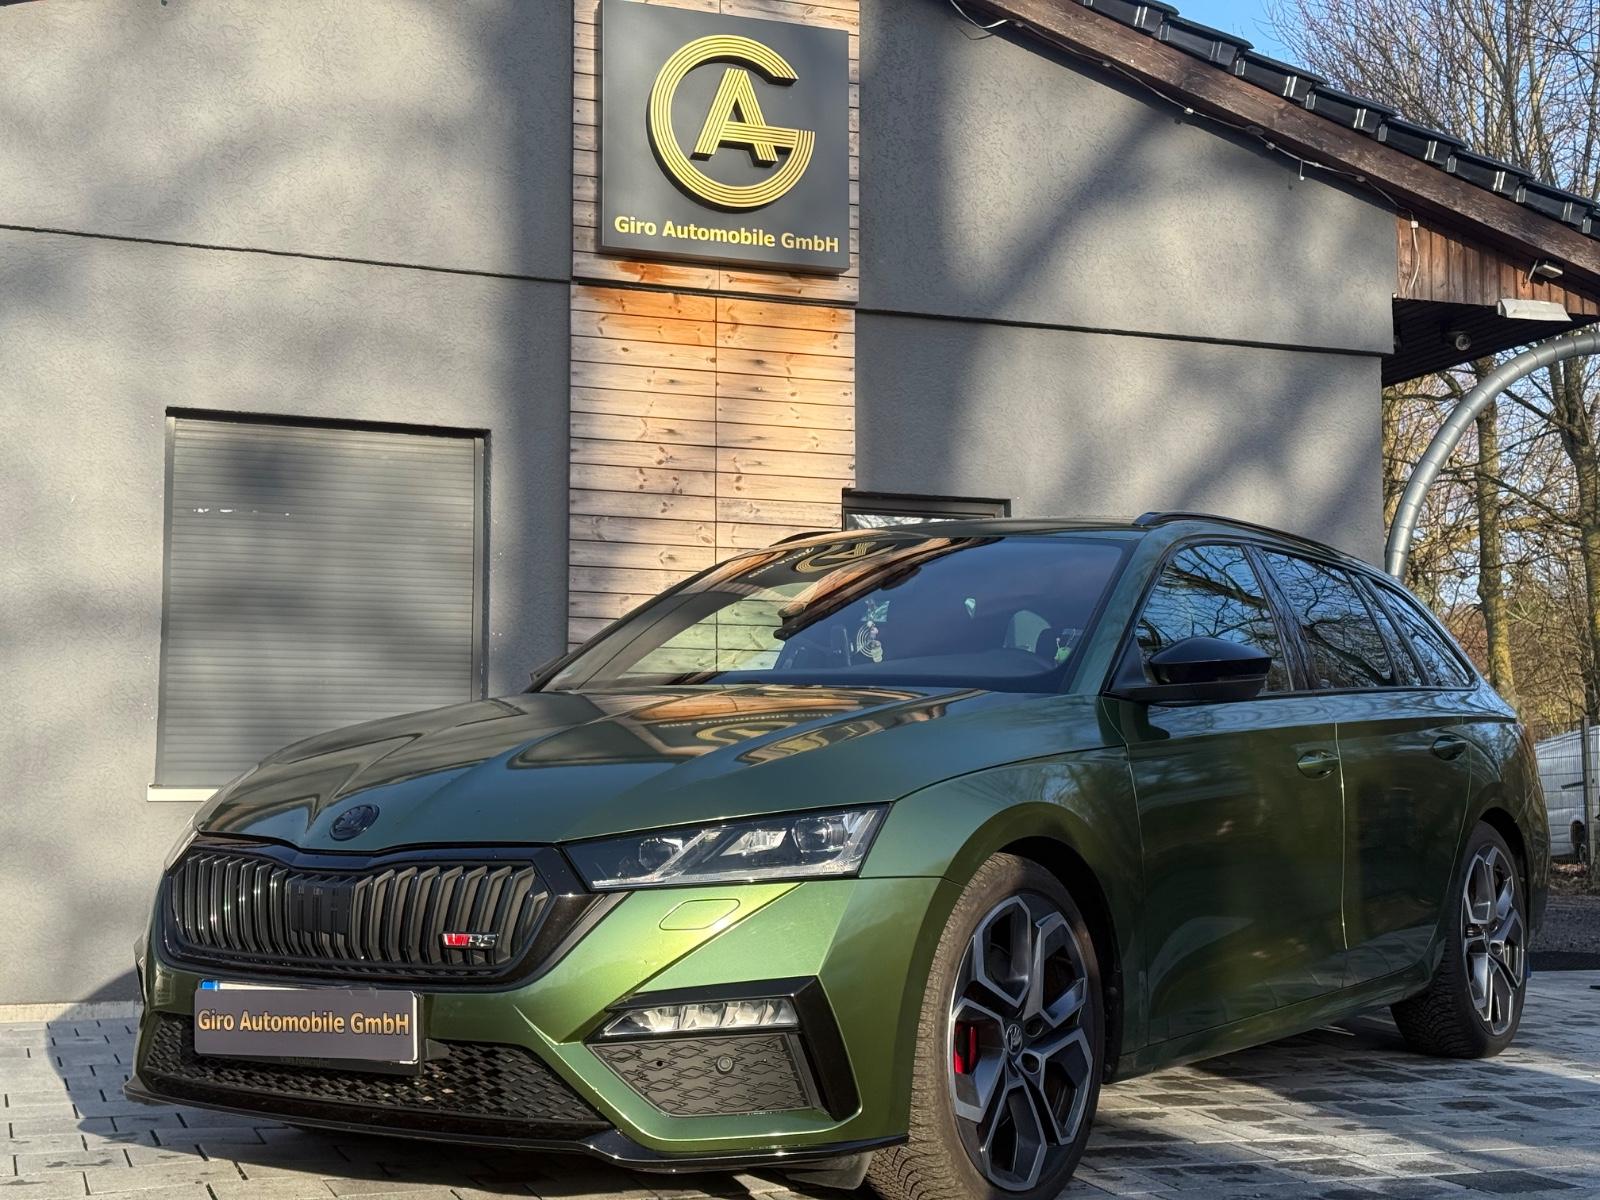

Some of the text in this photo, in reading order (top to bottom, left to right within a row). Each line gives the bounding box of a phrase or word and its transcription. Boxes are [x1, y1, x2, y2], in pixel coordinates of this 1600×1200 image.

[614, 216, 839, 253] Giro Automobile GmbH
[198, 1009, 409, 1035] Giro Automobile GmbH
